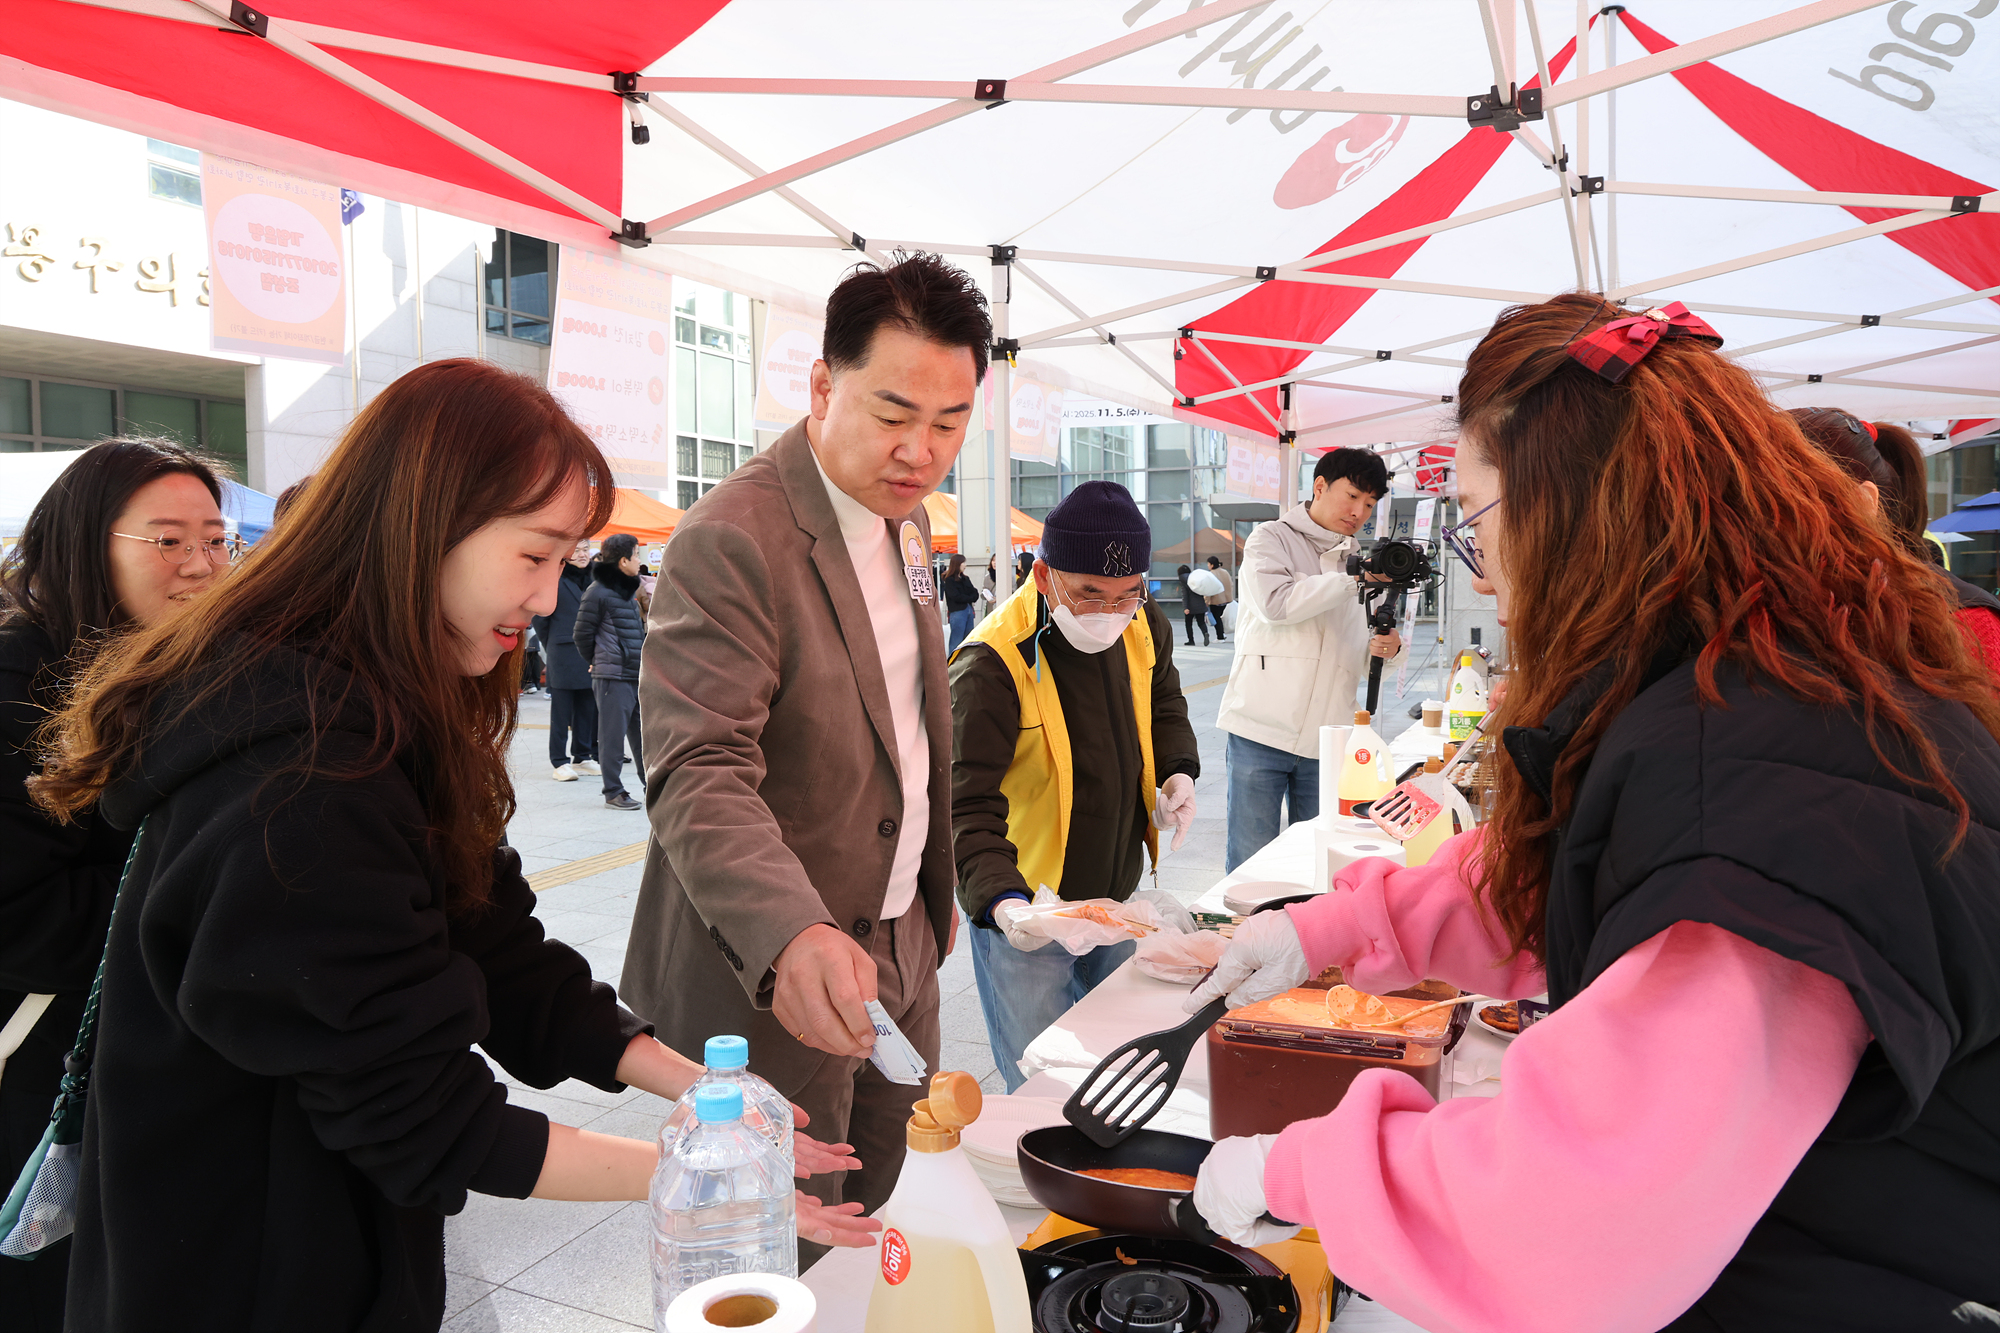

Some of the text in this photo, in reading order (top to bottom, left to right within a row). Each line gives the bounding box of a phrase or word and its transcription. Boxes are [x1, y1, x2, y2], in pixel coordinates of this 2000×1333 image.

[1103, 540, 1132, 577] NY
[911, 578, 931, 593] 오언석
[1452, 717, 1471, 725] 콩기름
[885, 1241, 902, 1272] 1등
